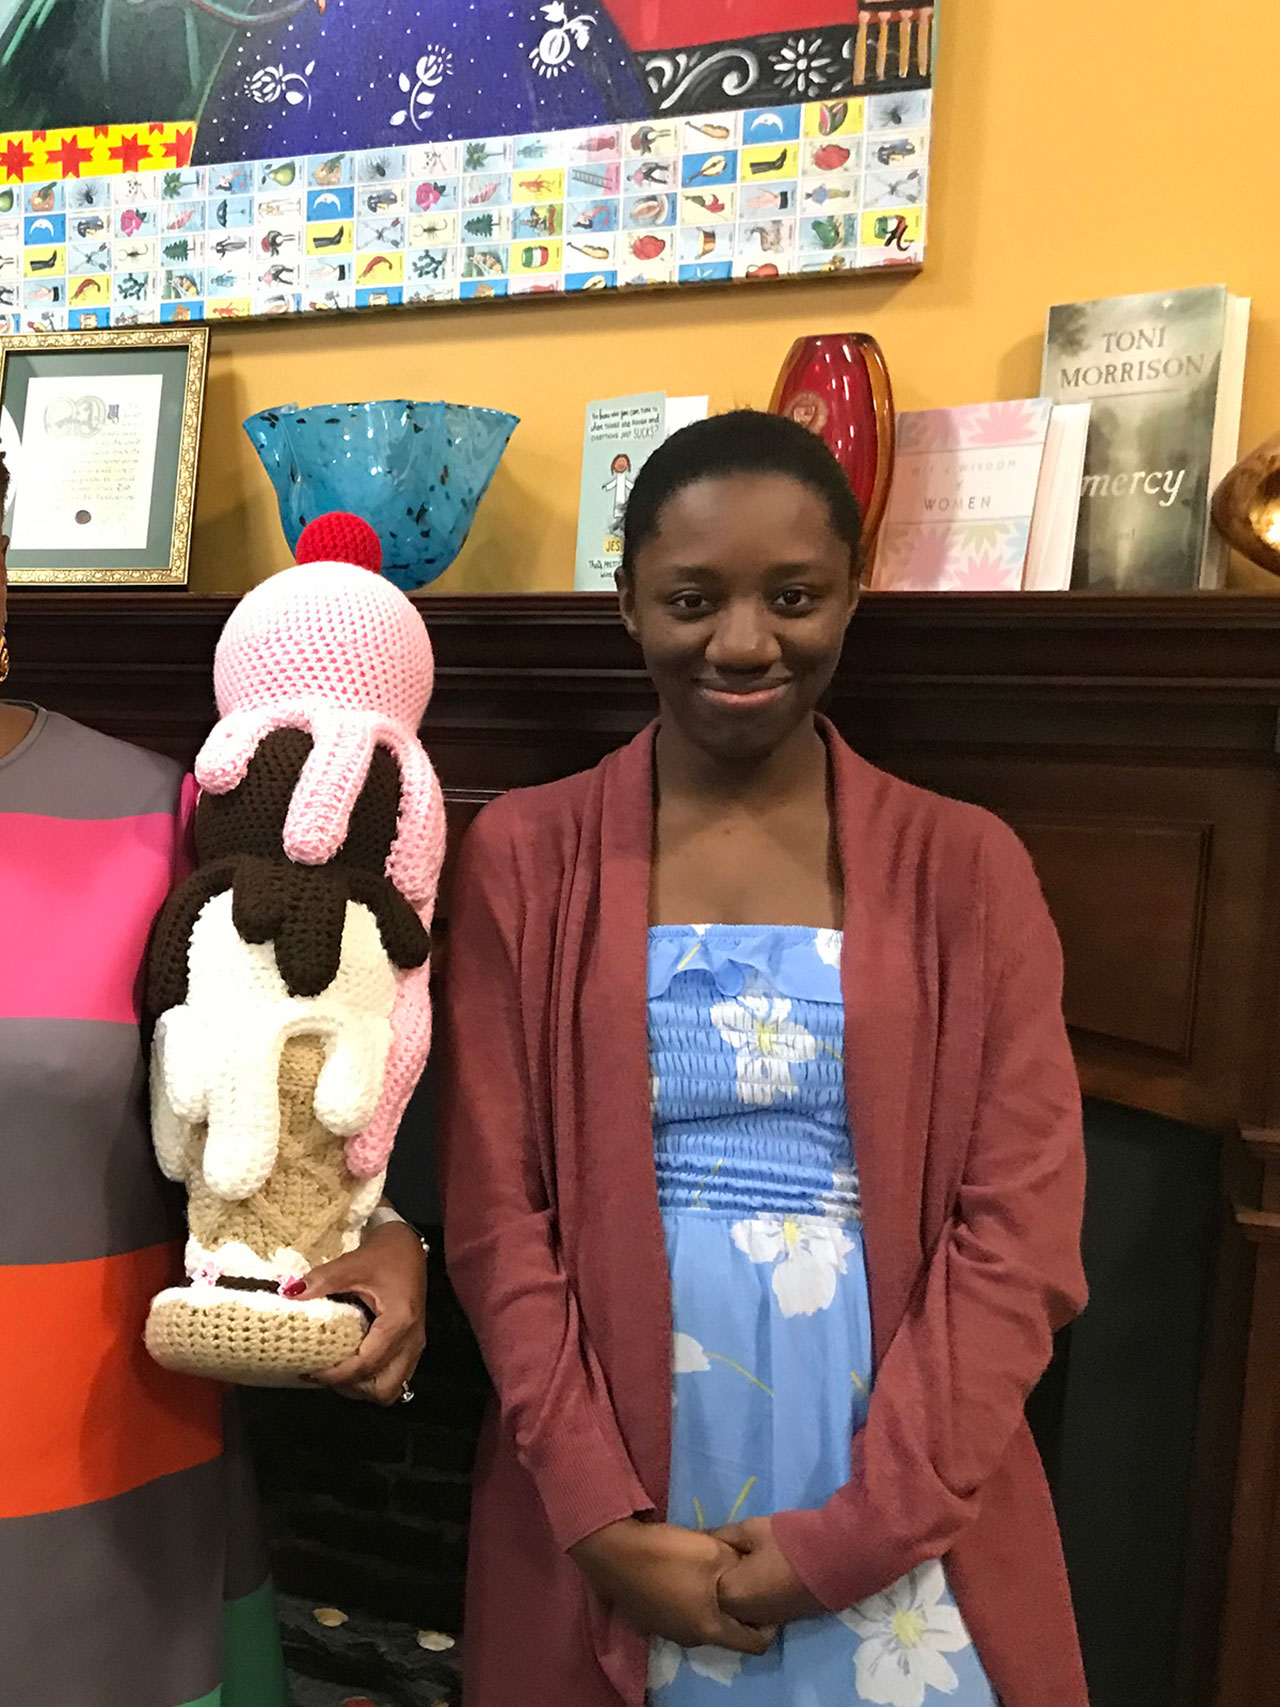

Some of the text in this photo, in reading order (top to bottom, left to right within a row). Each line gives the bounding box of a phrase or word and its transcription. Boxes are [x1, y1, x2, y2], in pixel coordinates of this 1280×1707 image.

[1102, 326, 1166, 354] TONI
[1060, 353, 1205, 389] MORRISON
[923, 495, 992, 512] WOMEN
